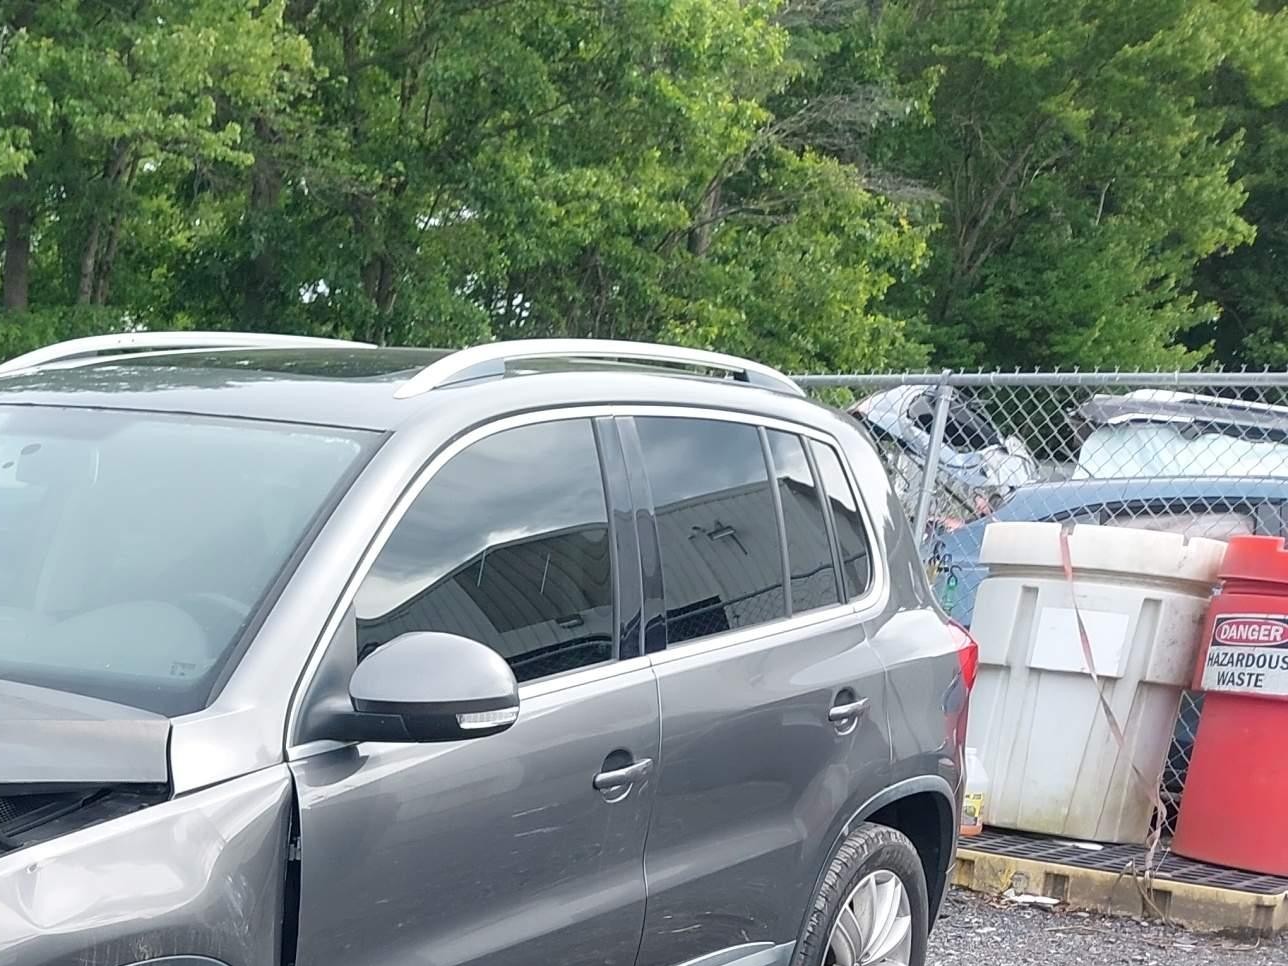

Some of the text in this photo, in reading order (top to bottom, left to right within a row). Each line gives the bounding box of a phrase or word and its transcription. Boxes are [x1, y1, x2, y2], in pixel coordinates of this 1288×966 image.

[1220, 624, 1284, 640] DANGER
[1207, 652, 1288, 670] HAZARDOUS
[1216, 671, 1265, 688] WASTE
